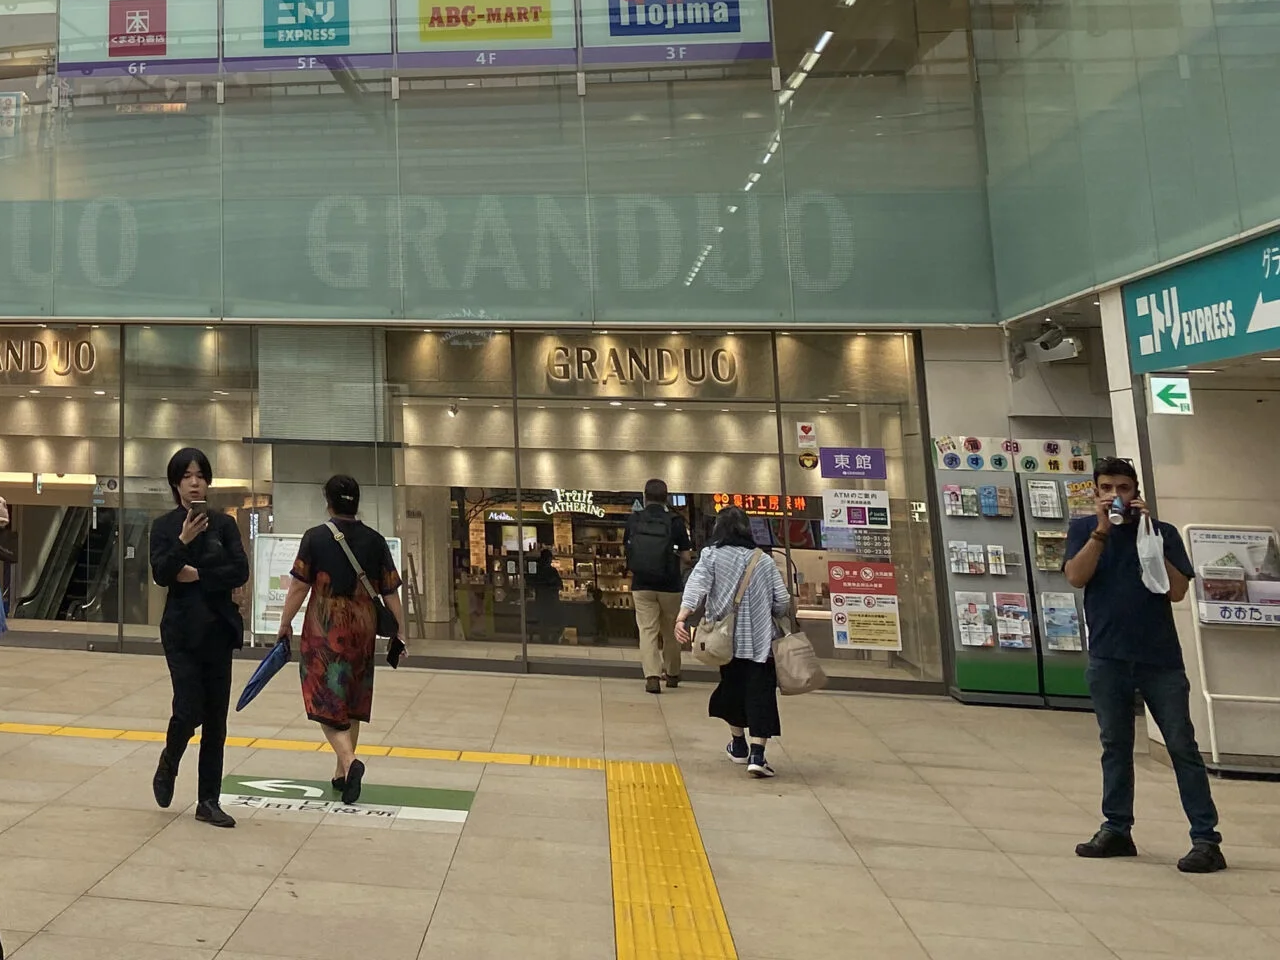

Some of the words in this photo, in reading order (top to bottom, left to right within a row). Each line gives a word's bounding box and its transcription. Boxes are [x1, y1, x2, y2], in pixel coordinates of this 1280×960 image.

[278, 1, 335, 25] ニトリ
[428, 5, 543, 29] ABC-MART
[278, 28, 336, 42] EXPRESS
[307, 190, 856, 293] GRANDUO
[1136, 286, 1181, 355] ニトリ
[1181, 300, 1236, 346] EXPRESS
[546, 346, 737, 385] GRANDUO
[834, 454, 872, 470] 東館
[552, 488, 593, 505] Fruit
[542, 501, 605, 518] GATHERING
